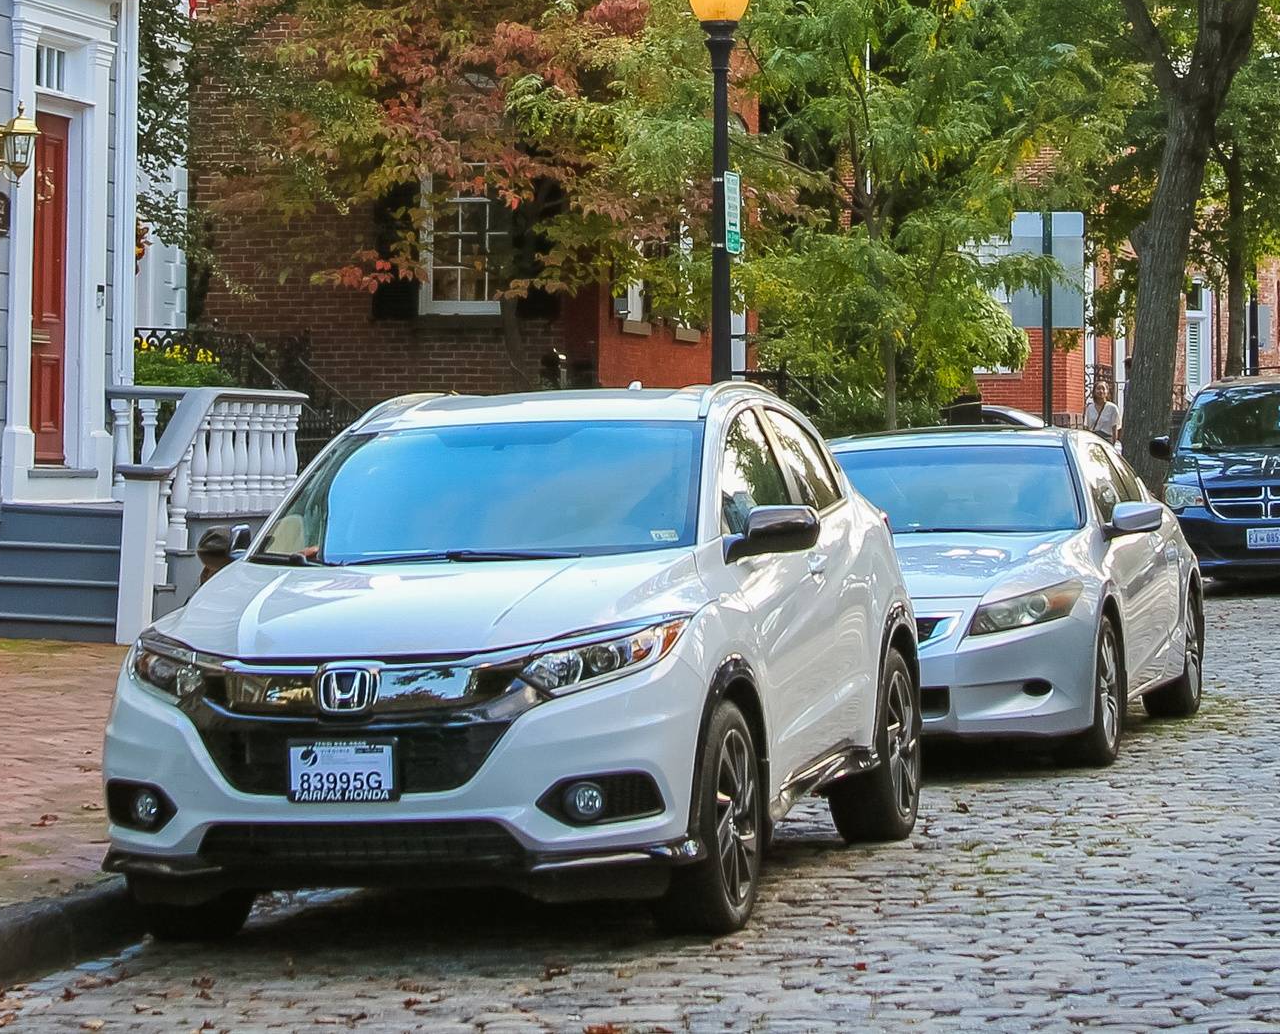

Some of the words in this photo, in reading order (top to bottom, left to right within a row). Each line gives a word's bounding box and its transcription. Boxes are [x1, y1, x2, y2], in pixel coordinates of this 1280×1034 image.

[300, 771, 383, 790] 83995G
[295, 789, 342, 802] FAIRFAX
[345, 789, 390, 801] HONDA
